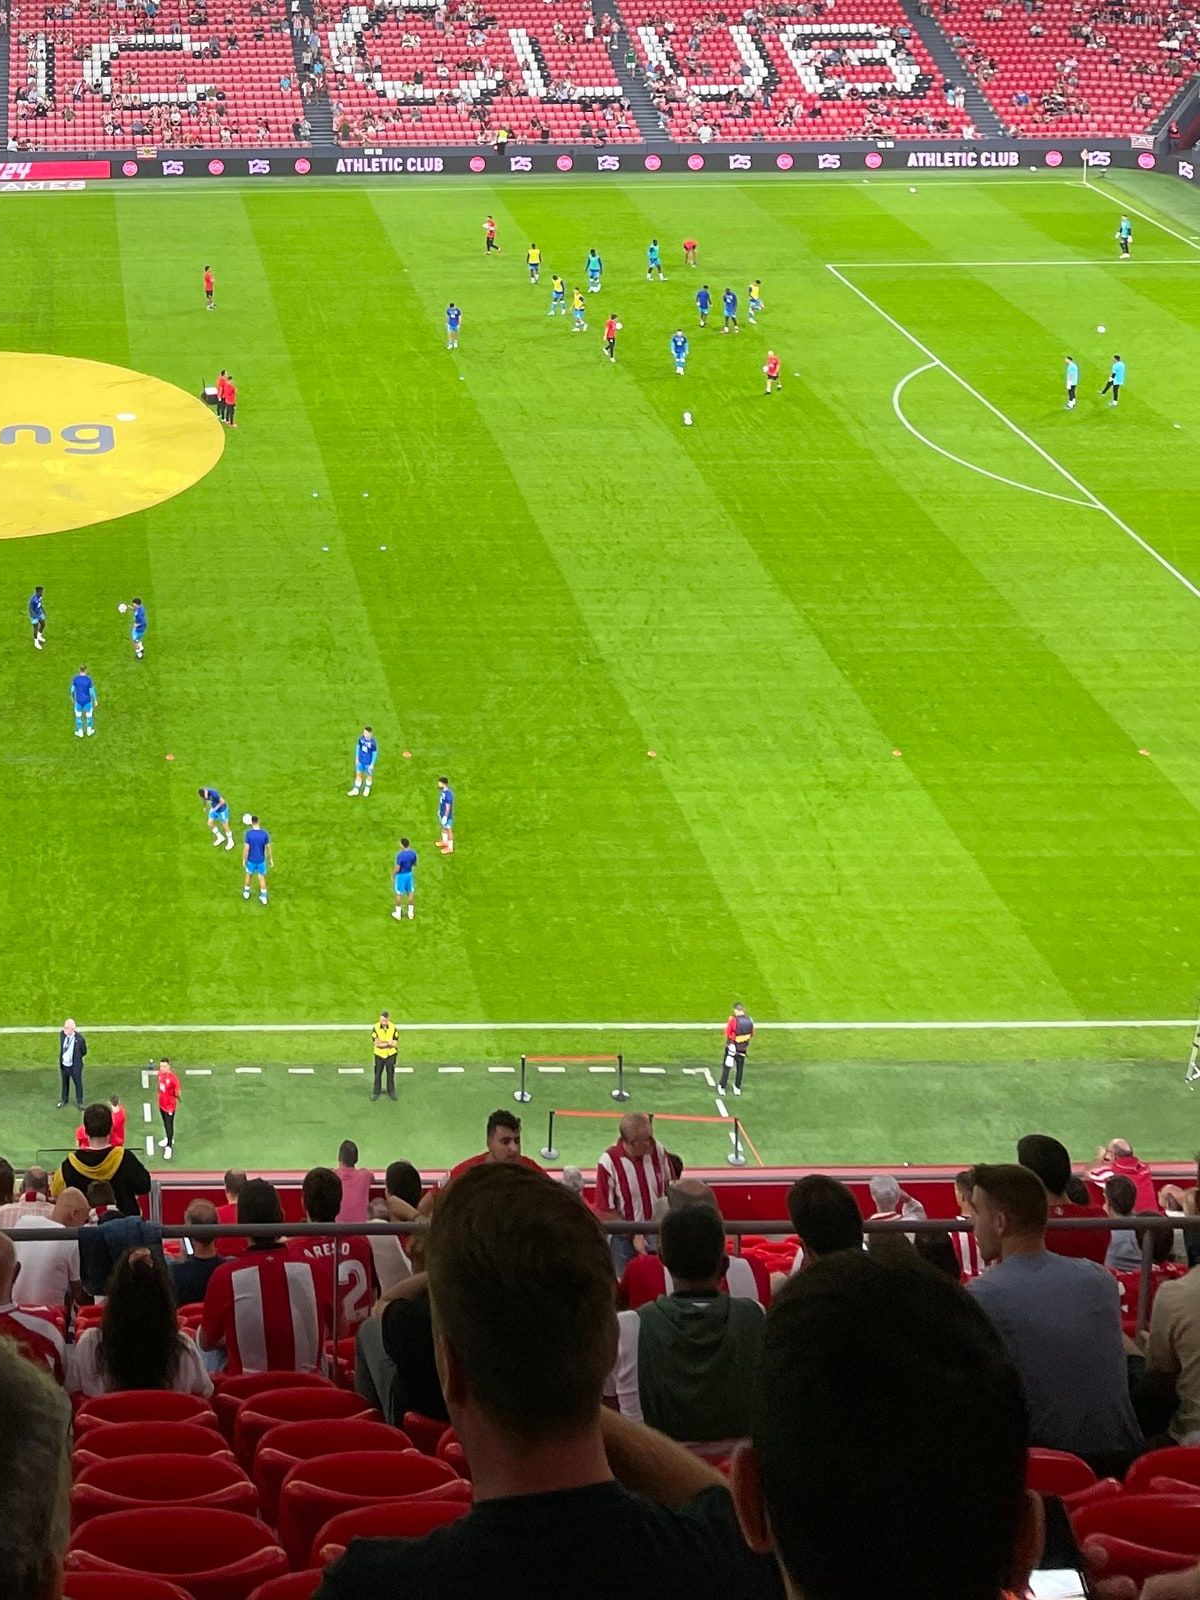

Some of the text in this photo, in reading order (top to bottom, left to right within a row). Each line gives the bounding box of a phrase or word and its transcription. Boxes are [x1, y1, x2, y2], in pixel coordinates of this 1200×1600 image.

[248, 158, 270, 175] 125
[336, 158, 443, 172] ATHLETIC CLUB
[510, 155, 532, 171] 125
[597, 155, 619, 171] 125
[729, 153, 751, 170] 125
[818, 153, 840, 169] 125
[907, 152, 1018, 166] ATHLETIC CLUB
[162, 160, 184, 176] 125
